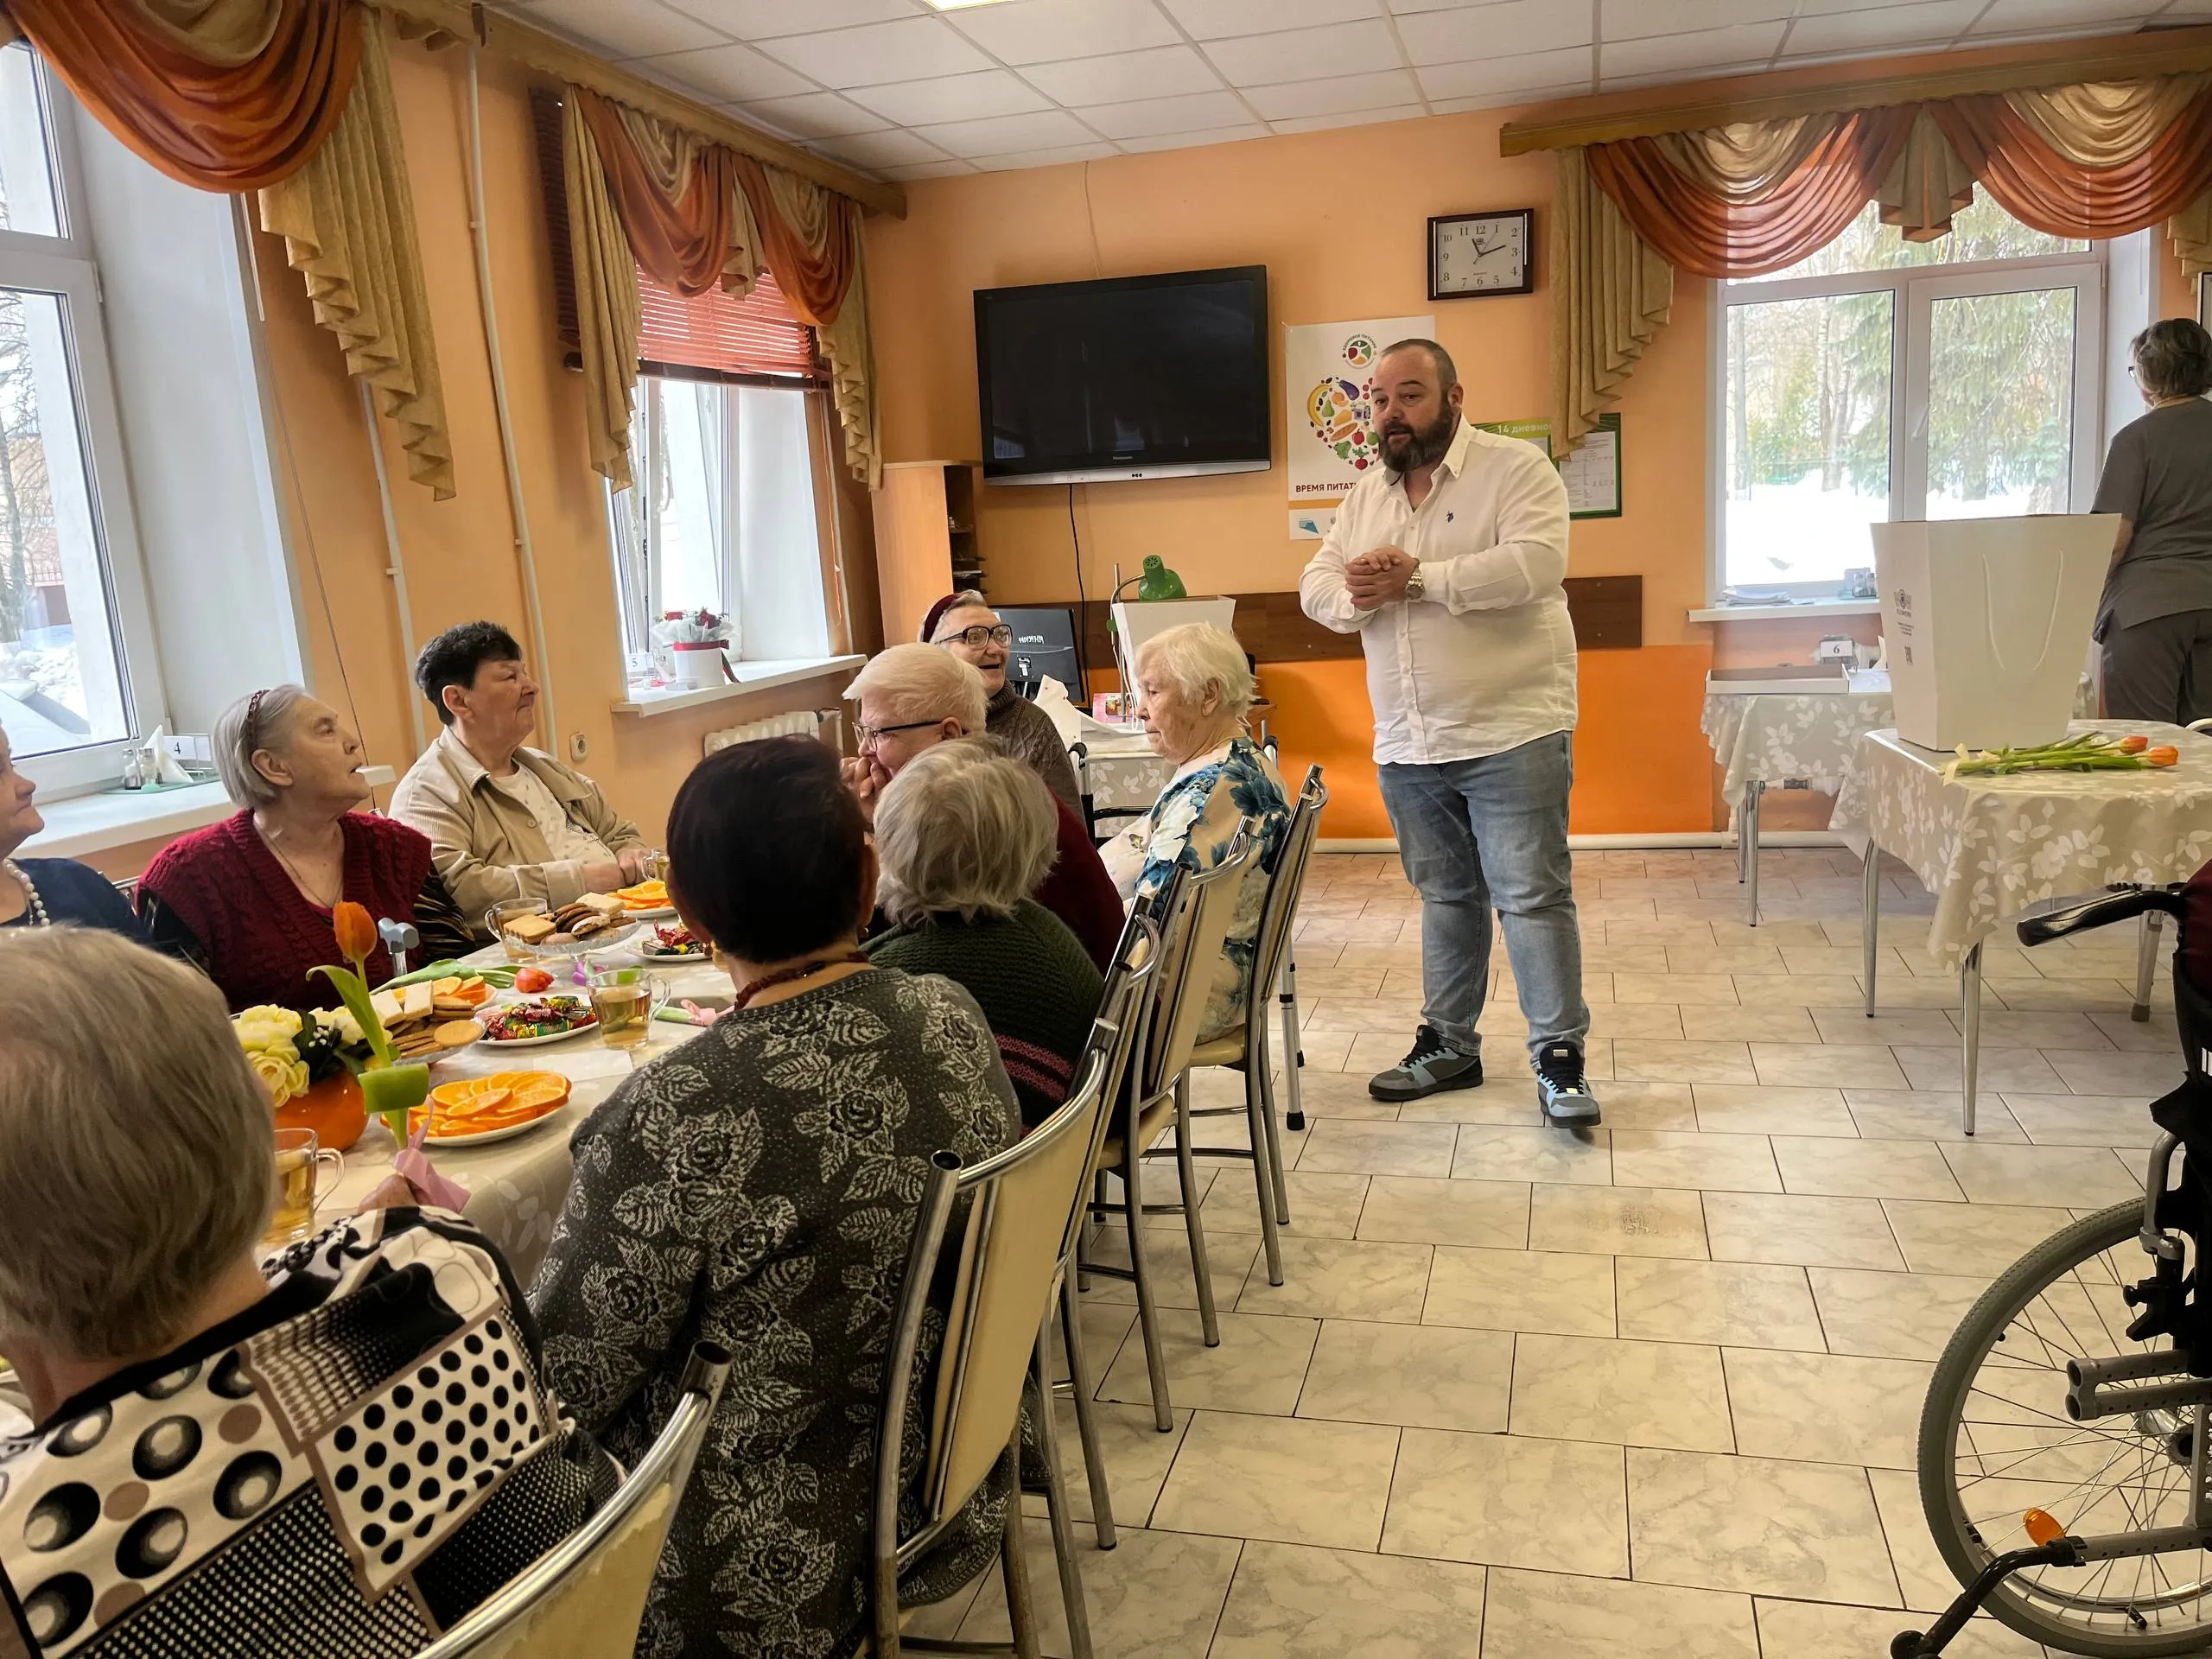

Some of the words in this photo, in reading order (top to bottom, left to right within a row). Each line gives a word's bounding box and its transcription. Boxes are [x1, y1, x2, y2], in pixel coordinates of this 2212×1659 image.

[1459, 227, 1468, 236] 11
[1476, 226, 1486, 234] 12
[1510, 227, 1518, 237] 2
[1443, 252, 1449, 261] 9
[1511, 247, 1518, 257] 3
[1510, 266, 1517, 276] 4
[1443, 272, 1450, 282] 8
[1461, 277, 1467, 287] 7
[1477, 276, 1484, 285] 6
[1493, 276, 1499, 284] 5
[1295, 484, 1325, 493] ВРЕМЯ
[1326, 482, 1357, 492] ПИТАТ
[1834, 644, 1840, 654] 6
[632, 658, 638, 667] 5
[174, 741, 181, 754] 4
